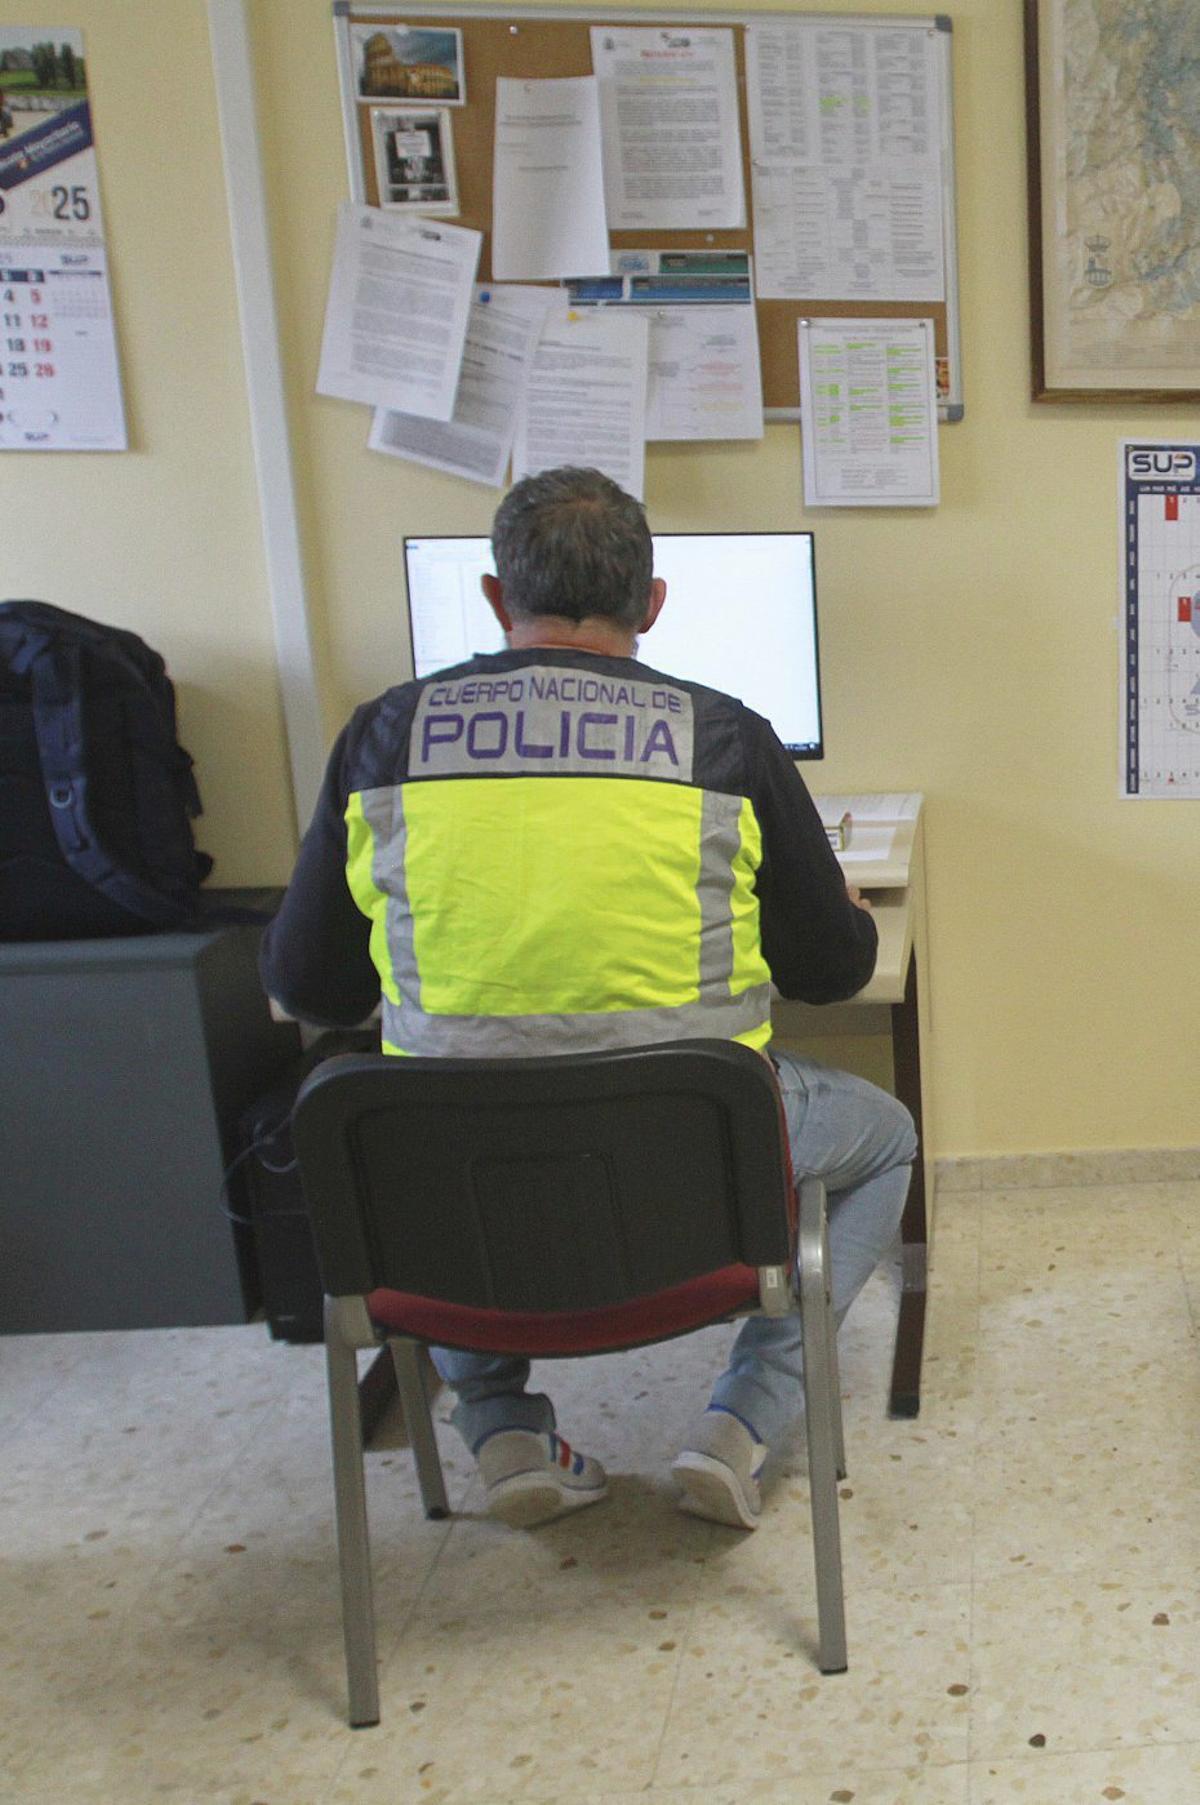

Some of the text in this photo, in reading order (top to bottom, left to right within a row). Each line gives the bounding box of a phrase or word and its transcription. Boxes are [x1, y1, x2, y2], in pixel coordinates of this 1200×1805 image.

[52, 186, 90, 221] 25
[4, 313, 21, 328] 11
[1133, 454, 1193, 474] SUP
[429, 676, 681, 712] CUERPO NACIONAL DE
[421, 711, 679, 766] POLICIA
